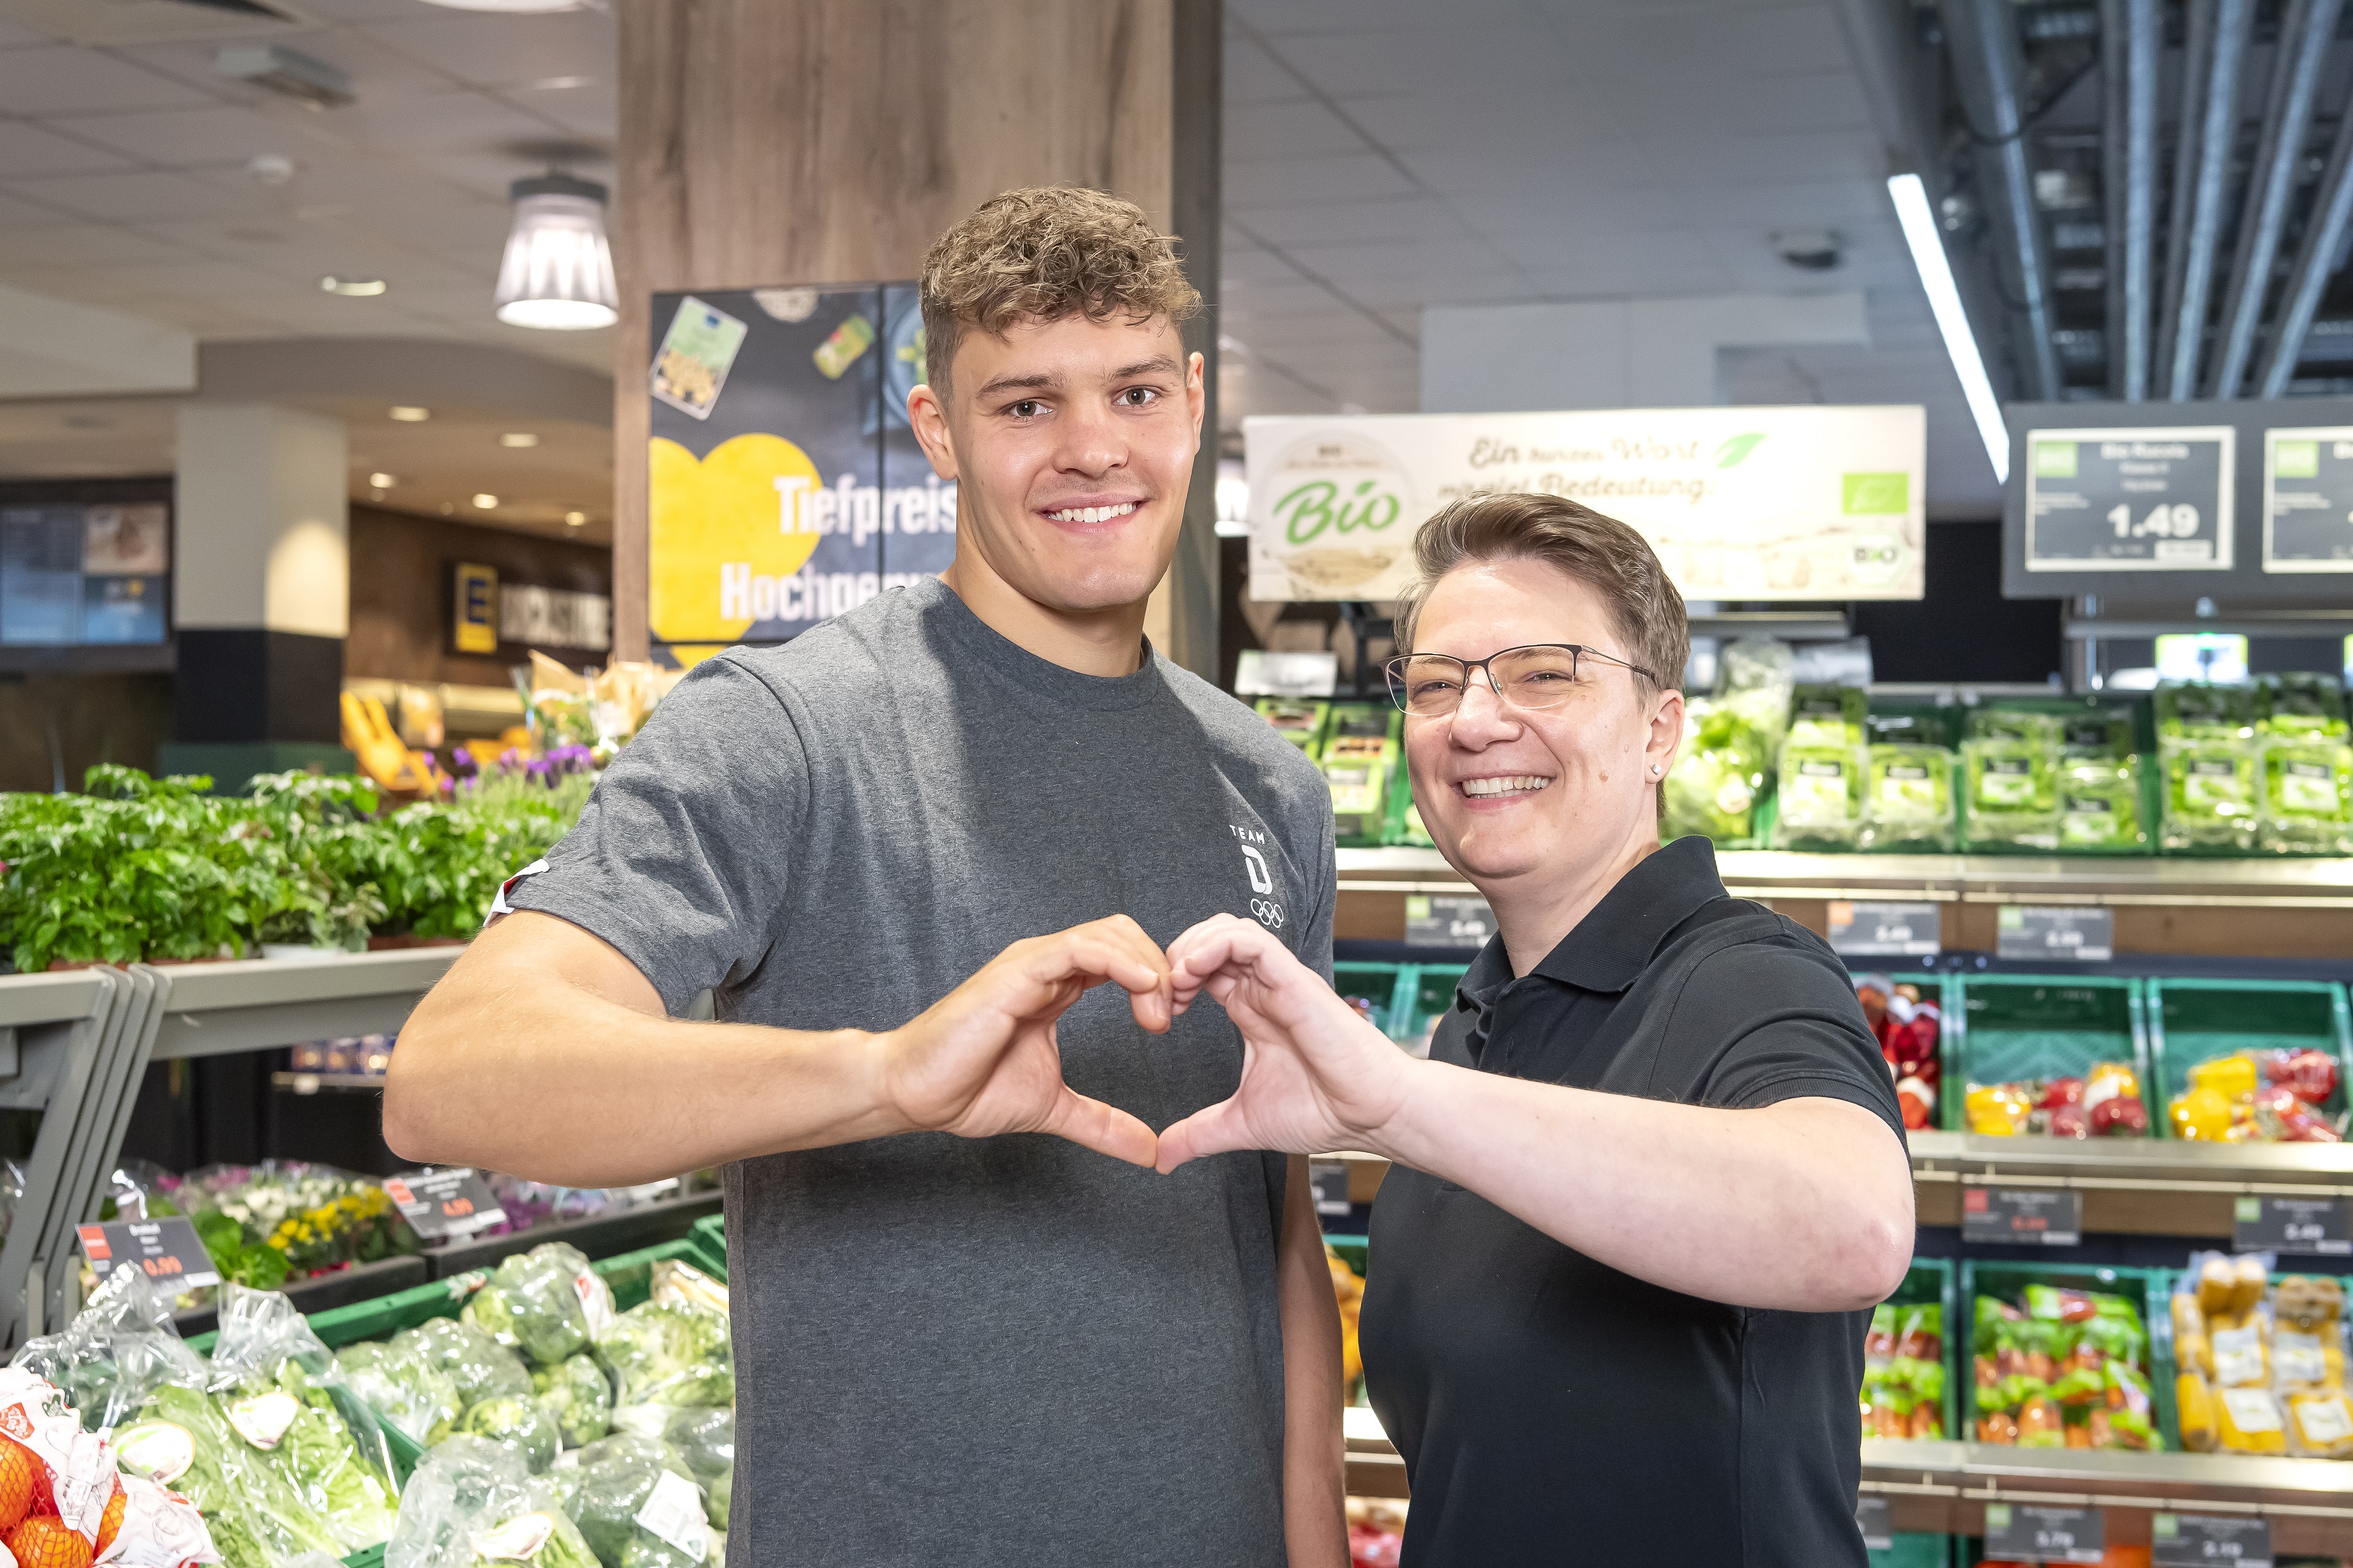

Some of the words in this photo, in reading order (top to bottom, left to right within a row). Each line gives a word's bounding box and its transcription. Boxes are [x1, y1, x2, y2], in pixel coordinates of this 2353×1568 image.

[1468, 438, 1519, 469] Ein
[1611, 436, 1698, 460] Wort
[773, 472, 957, 547] Tiefpreis
[1274, 479, 1401, 546] Bio
[2107, 503, 2200, 538] 1.49
[1229, 824, 1265, 845] TEAM
[1241, 844, 1273, 895] D
